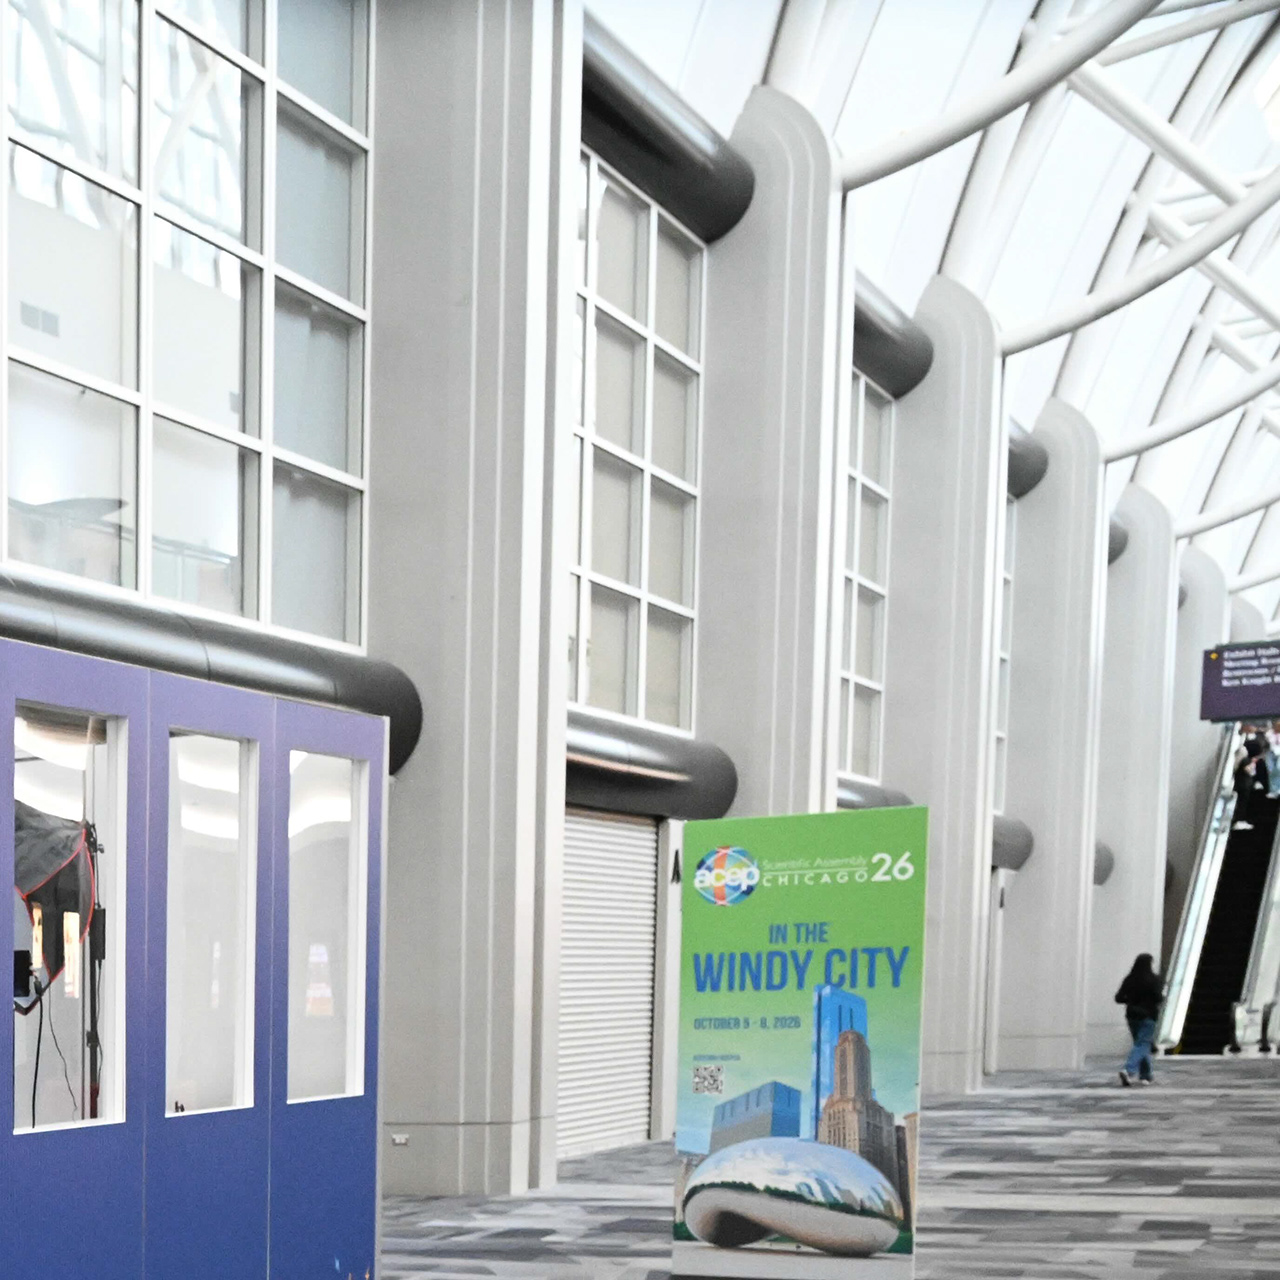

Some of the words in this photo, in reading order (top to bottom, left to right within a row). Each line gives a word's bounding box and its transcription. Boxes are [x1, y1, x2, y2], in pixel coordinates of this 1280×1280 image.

[694, 867, 760, 891] acep
[762, 871, 868, 887] CHICAGO
[870, 851, 915, 882] 26
[768, 923, 788, 944] IN
[793, 921, 829, 943] THE
[693, 949, 815, 993] WINDY
[823, 946, 910, 989] CITY
[694, 1017, 740, 1029] OCTOBER
